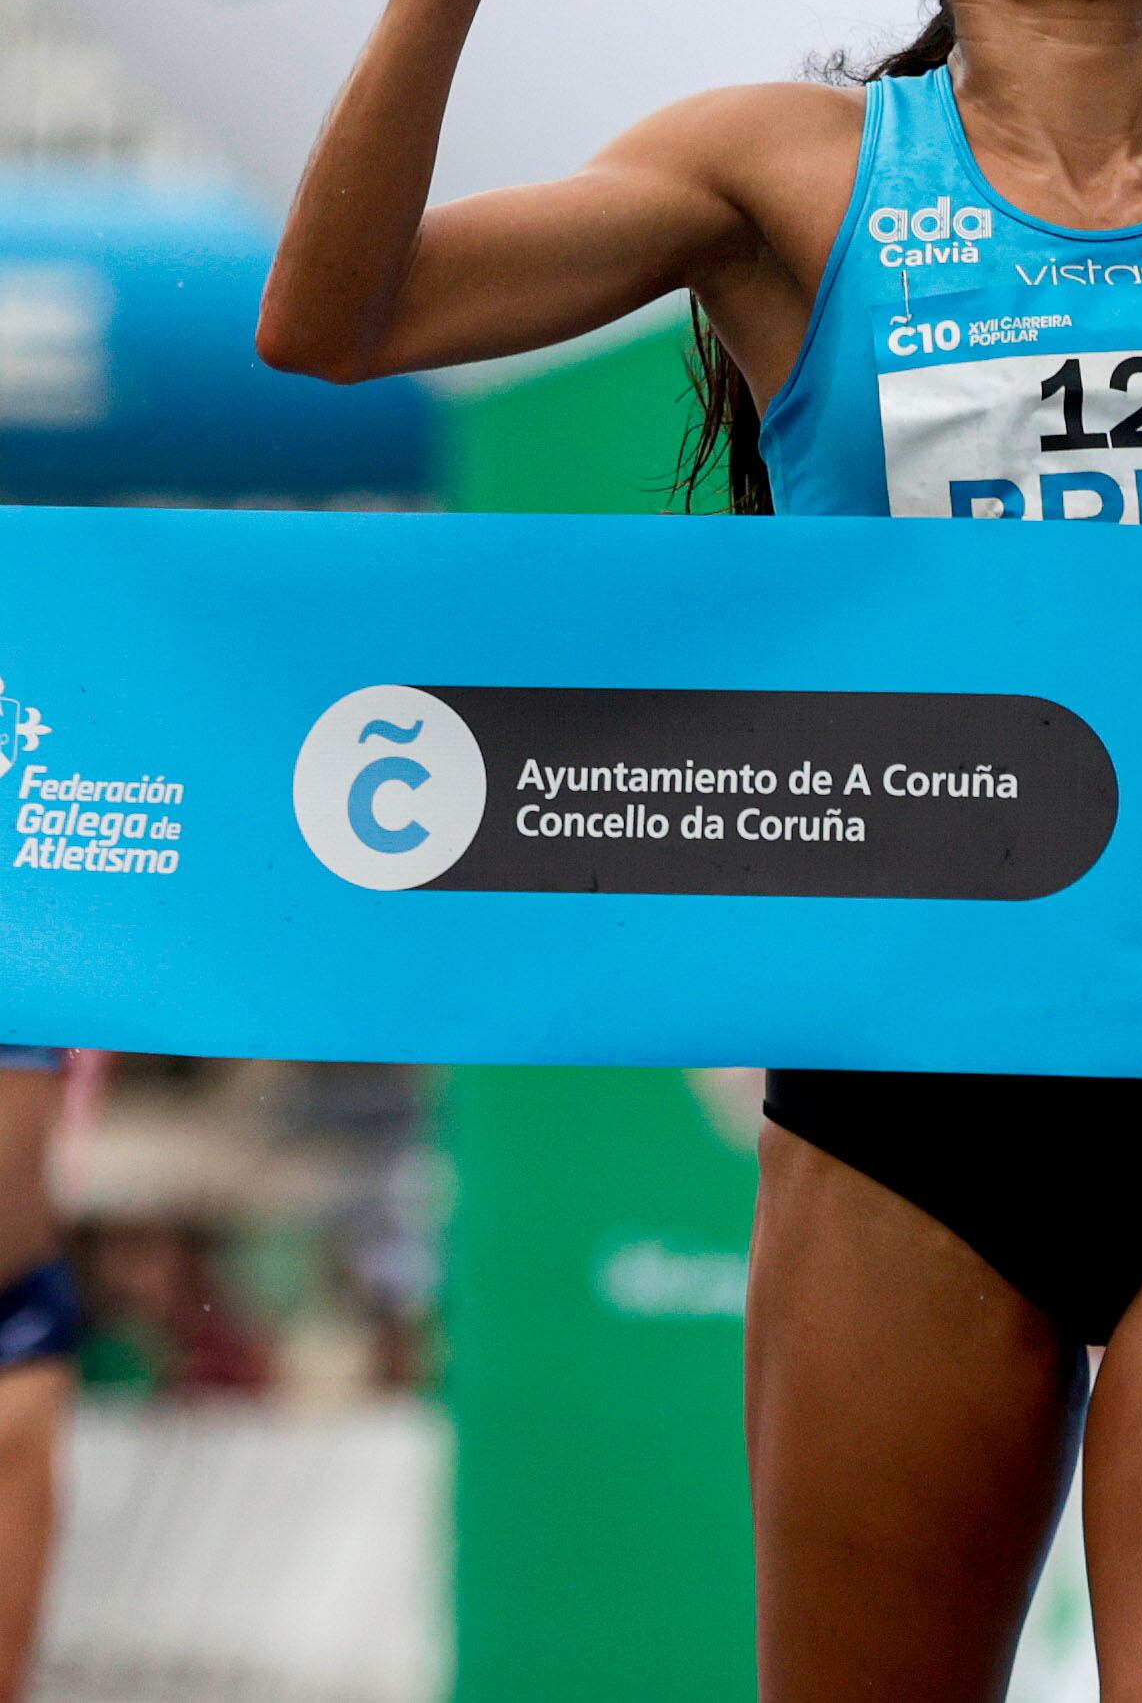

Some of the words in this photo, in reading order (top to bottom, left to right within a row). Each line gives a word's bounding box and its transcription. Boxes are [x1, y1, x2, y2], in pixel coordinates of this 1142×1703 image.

[869, 196, 992, 243] ada
[880, 242, 979, 268] Calvià
[968, 318, 999, 336] XVII
[1000, 314, 1073, 330] CARREIRA
[968, 329, 1039, 347] POPULAR
[19, 764, 185, 804] Federación
[516, 759, 778, 799] Ayuntamiento
[788, 761, 834, 795] de
[843, 763, 872, 796] A
[882, 764, 1019, 799] Coruña
[16, 802, 148, 846] Galega
[150, 816, 182, 840] de
[516, 805, 670, 840] Concello
[680, 806, 725, 840] da
[736, 808, 867, 842] Coruña
[13, 836, 180, 874] Atletismo
